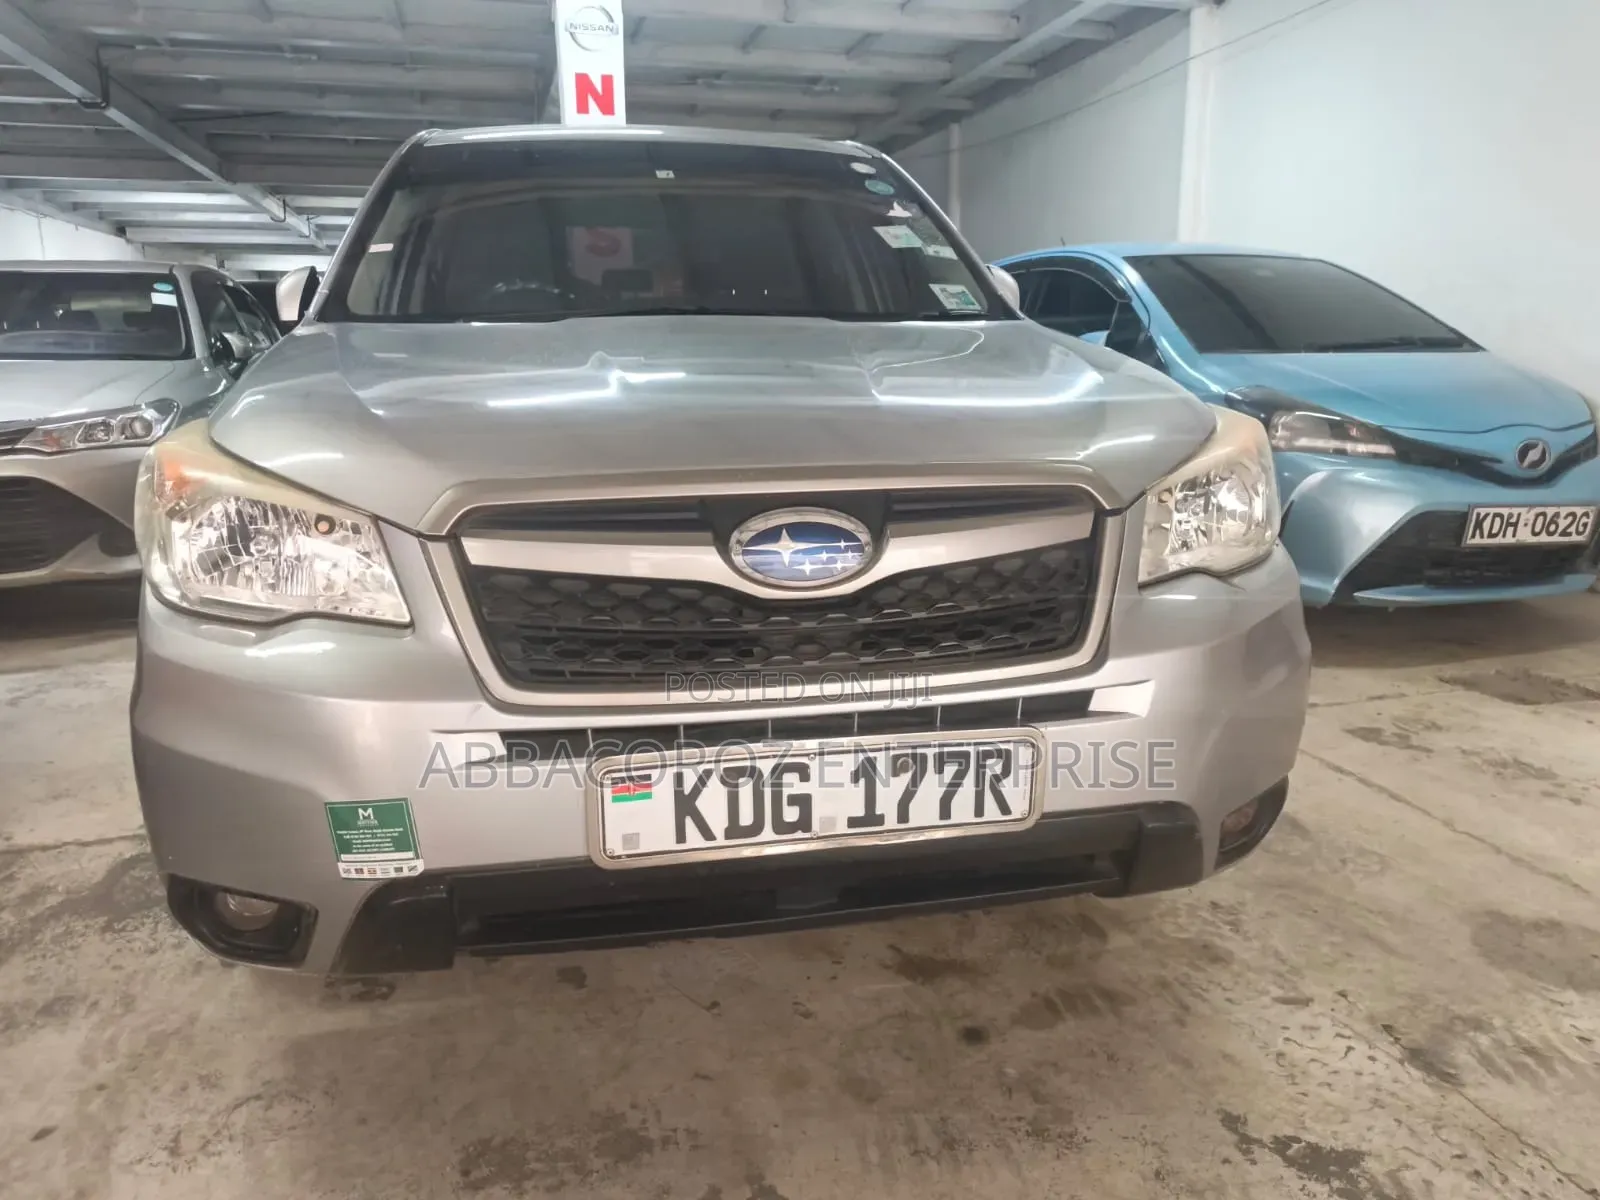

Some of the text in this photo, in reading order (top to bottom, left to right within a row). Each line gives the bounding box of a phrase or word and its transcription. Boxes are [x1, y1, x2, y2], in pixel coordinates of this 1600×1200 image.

[569, 22, 614, 33] NISSAN
[1470, 510, 1591, 540] KDH 062G
[673, 761, 813, 844] KDG
[847, 747, 1013, 828] 177R
[358, 807, 375, 820] M
